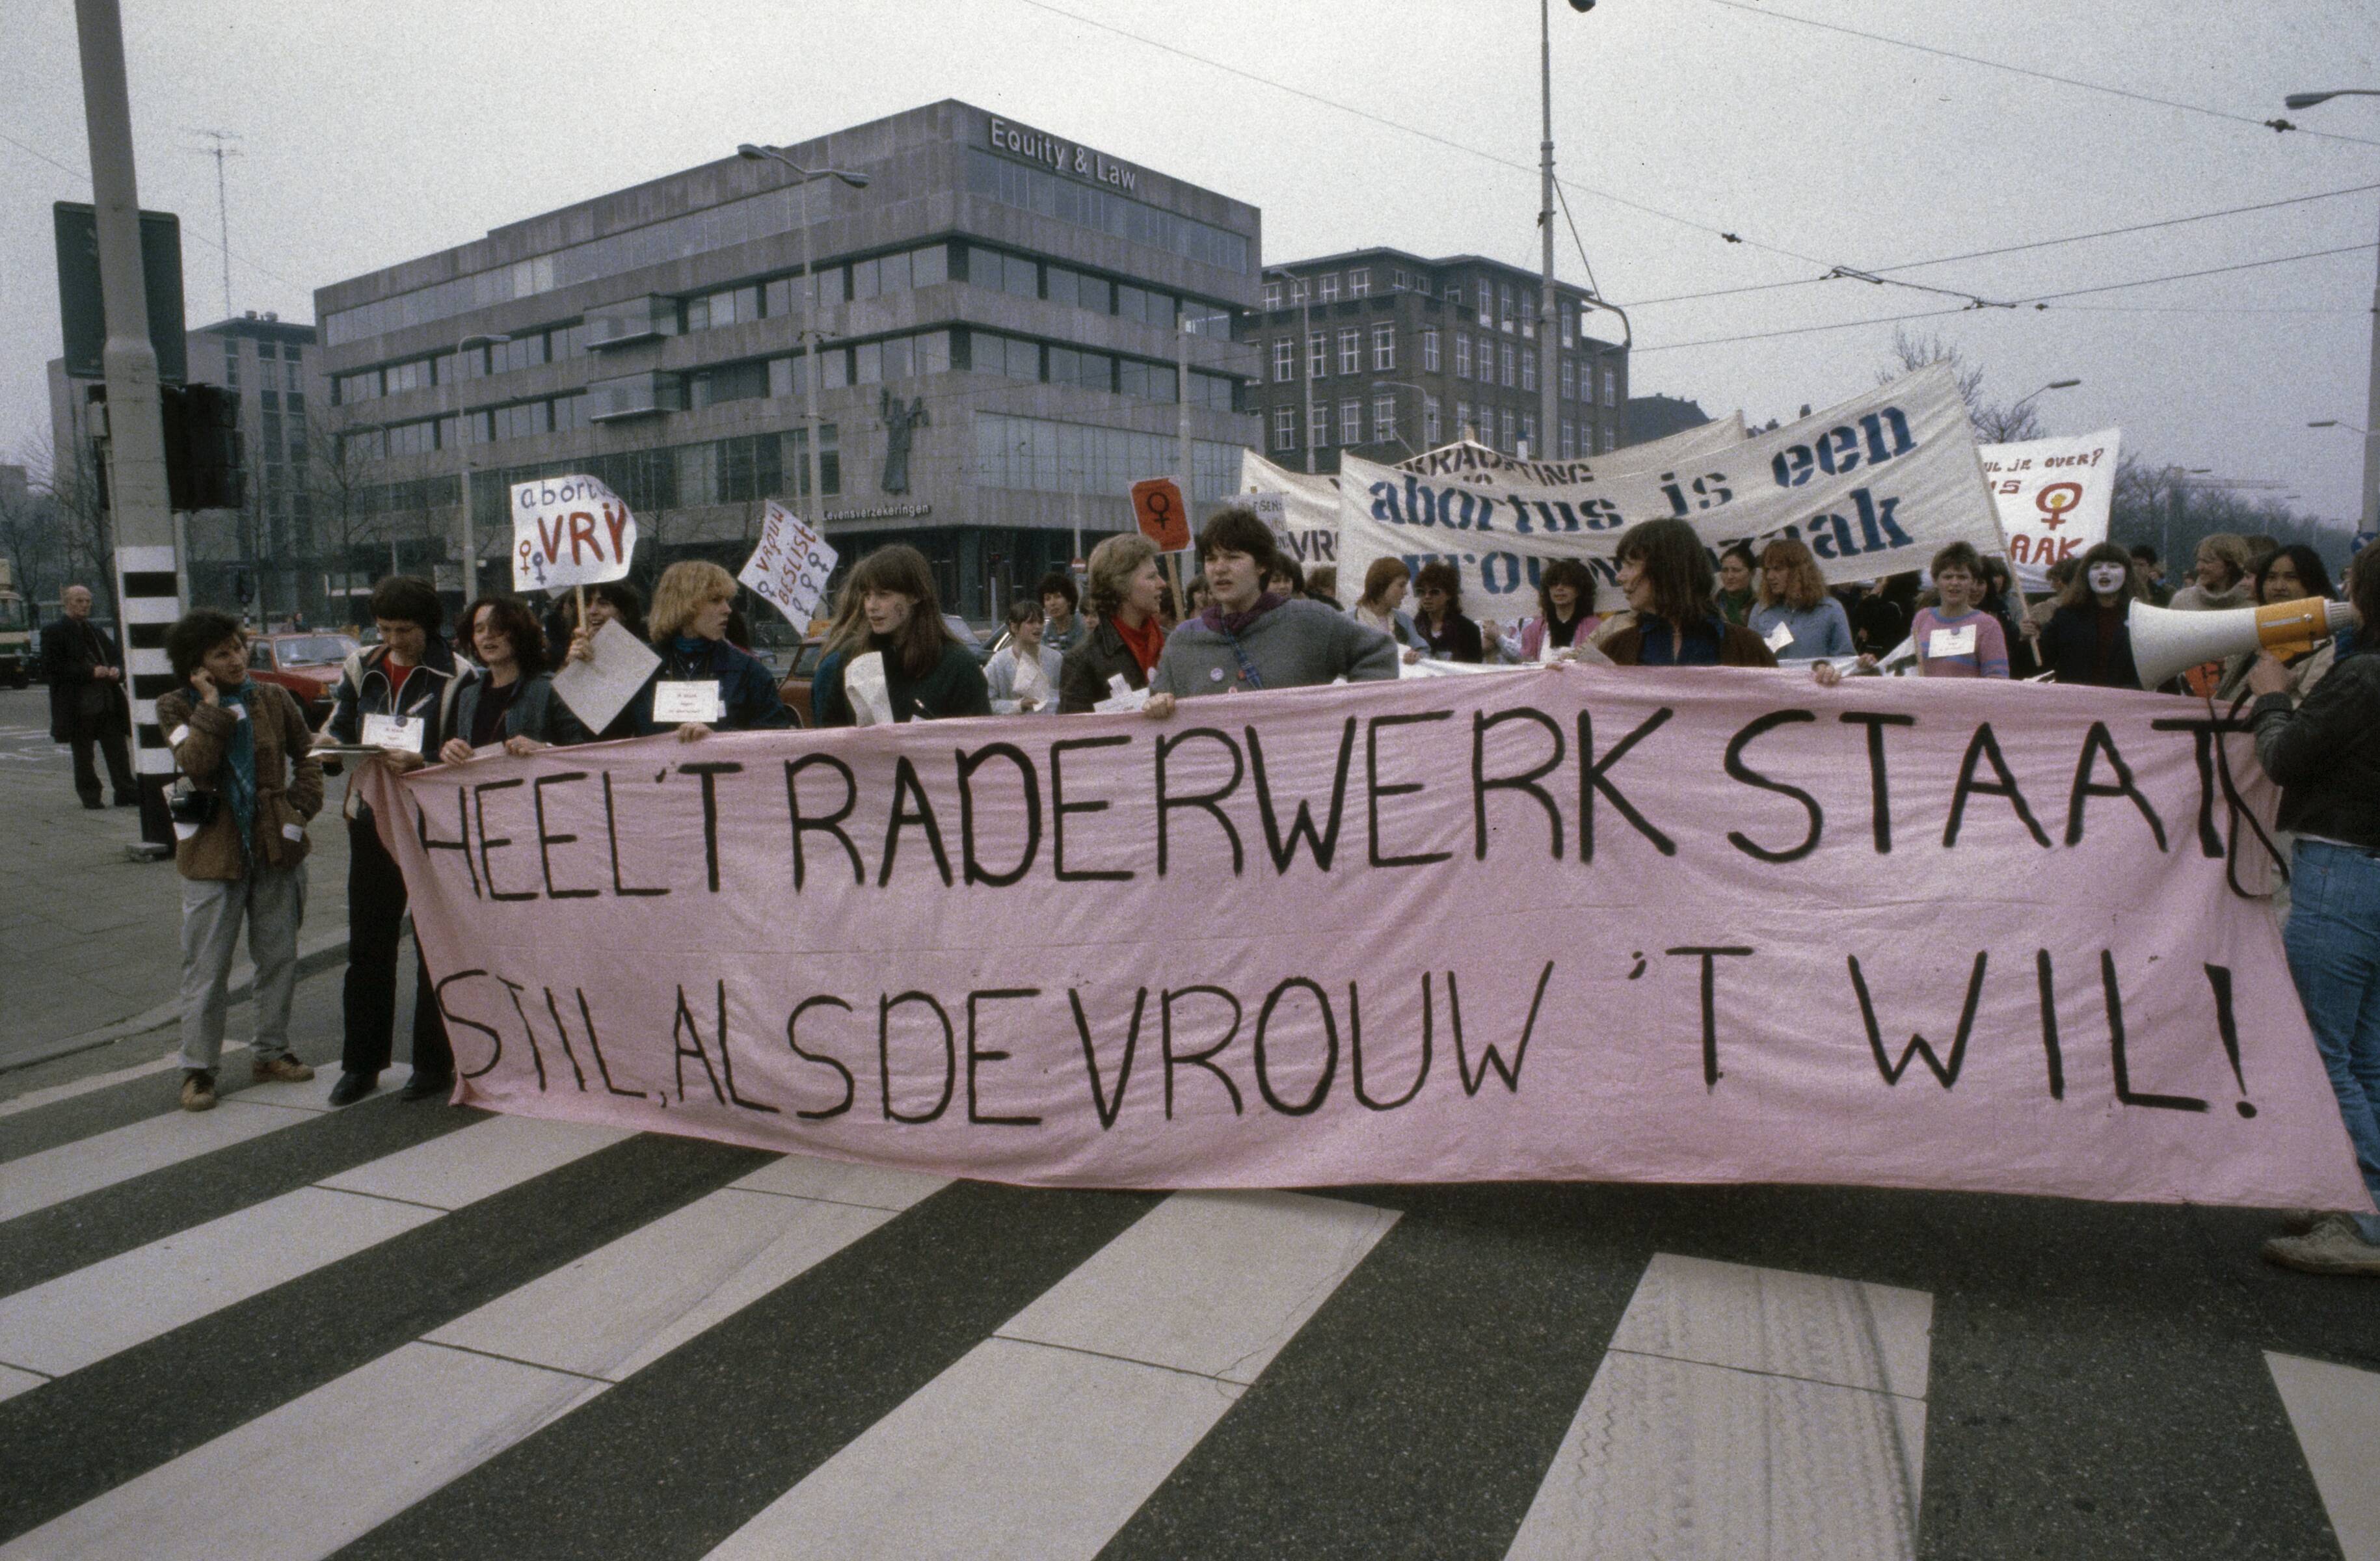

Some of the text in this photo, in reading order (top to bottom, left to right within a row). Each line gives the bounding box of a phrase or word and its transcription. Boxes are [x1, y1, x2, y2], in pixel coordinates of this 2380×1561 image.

[991, 117, 1135, 190] Equity & Law
[1369, 406, 1918, 534] abortus is een
[2044, 447, 2104, 468] OVER?
[1287, 529, 1339, 563] VR
[2011, 534, 2083, 565] AAK
[410, 771, 670, 902] HEEL
[784, 706, 1676, 892] RADERWERK
[1724, 708, 2255, 864] STAAT
[672, 980, 855, 1122] ALS
[879, 988, 1043, 1127] DE
[1068, 961, 1554, 1130] VROUW
[1847, 948, 2258, 1119] WIL!
